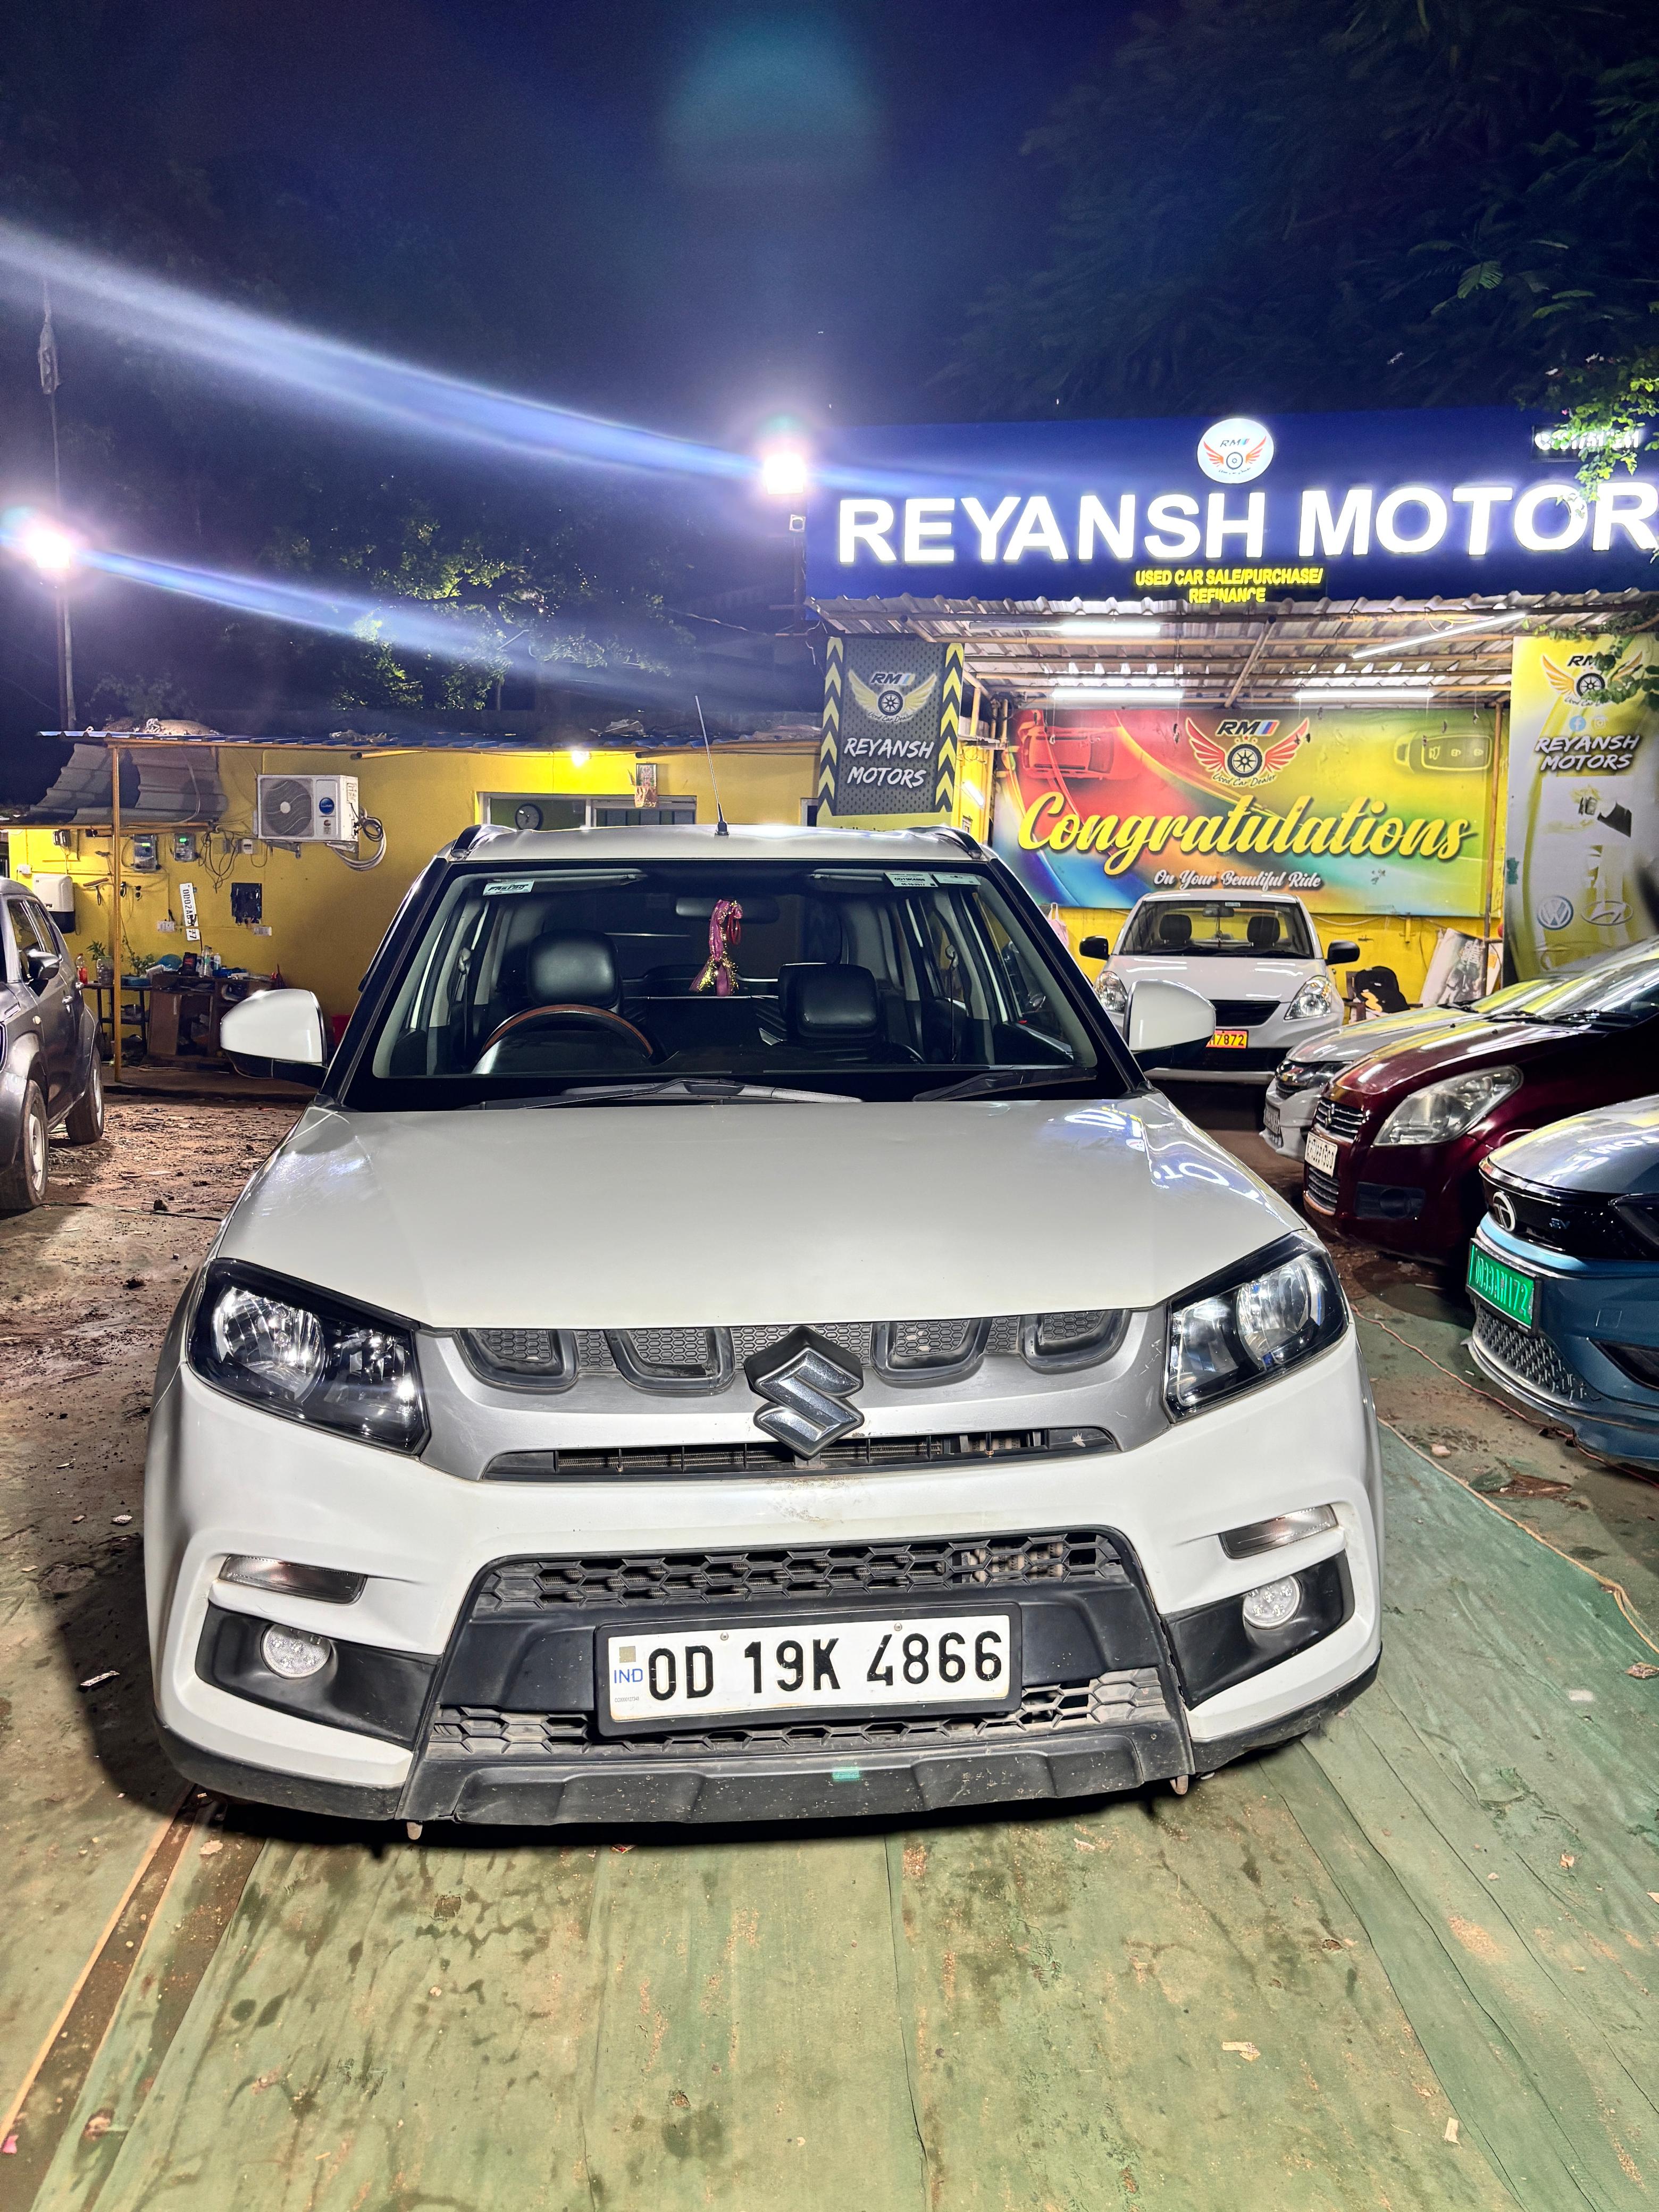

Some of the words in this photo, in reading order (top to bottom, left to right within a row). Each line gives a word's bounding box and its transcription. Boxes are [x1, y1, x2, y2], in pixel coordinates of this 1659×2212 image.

[839, 492, 1266, 563] REYANSH
[1297, 481, 1659, 557] MOTOR
[1135, 570, 1172, 586] USED
[1174, 569, 1203, 586] CAR
[1205, 567, 1323, 585] SALE/PURCHASE/
[843, 737, 935, 759] REYANSH
[1535, 735, 1640, 753] REYANSH
[1540, 753, 1633, 771] MOTORS
[847, 766, 927, 789] MOTORS
[1212, 773, 1233, 784] Used
[1233, 778, 1247, 787] Car
[1250, 774, 1276, 787] Dealer
[1017, 791, 1476, 876] Congratulations
[1153, 869, 1175, 885] On
[1179, 869, 1217, 891] Your
[1220, 870, 1285, 892] Beautiful
[1288, 871, 1322, 887] Ride
[614, 1668, 643, 1683] IND
[648, 1644, 714, 1701] OD
[744, 1637, 841, 1694] 19K
[866, 1630, 1002, 1687] 4866
